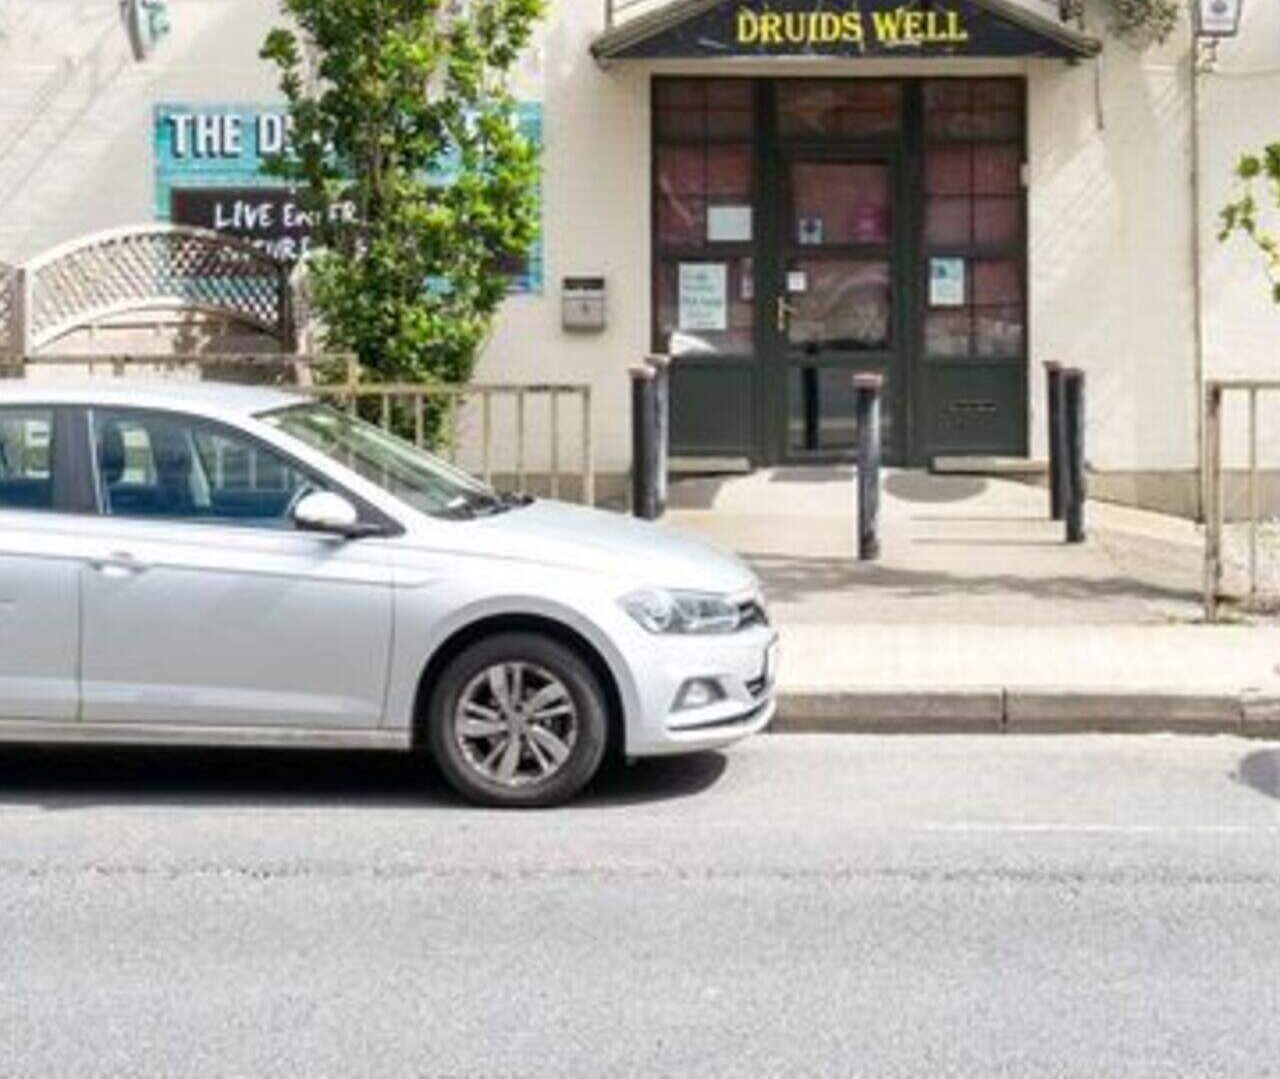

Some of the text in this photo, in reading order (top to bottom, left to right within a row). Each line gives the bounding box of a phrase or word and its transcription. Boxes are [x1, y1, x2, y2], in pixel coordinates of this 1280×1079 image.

[738, 10, 968, 43] DRUIDS WELL
[171, 113, 242, 158] THE
[214, 200, 273, 229] LIVE
